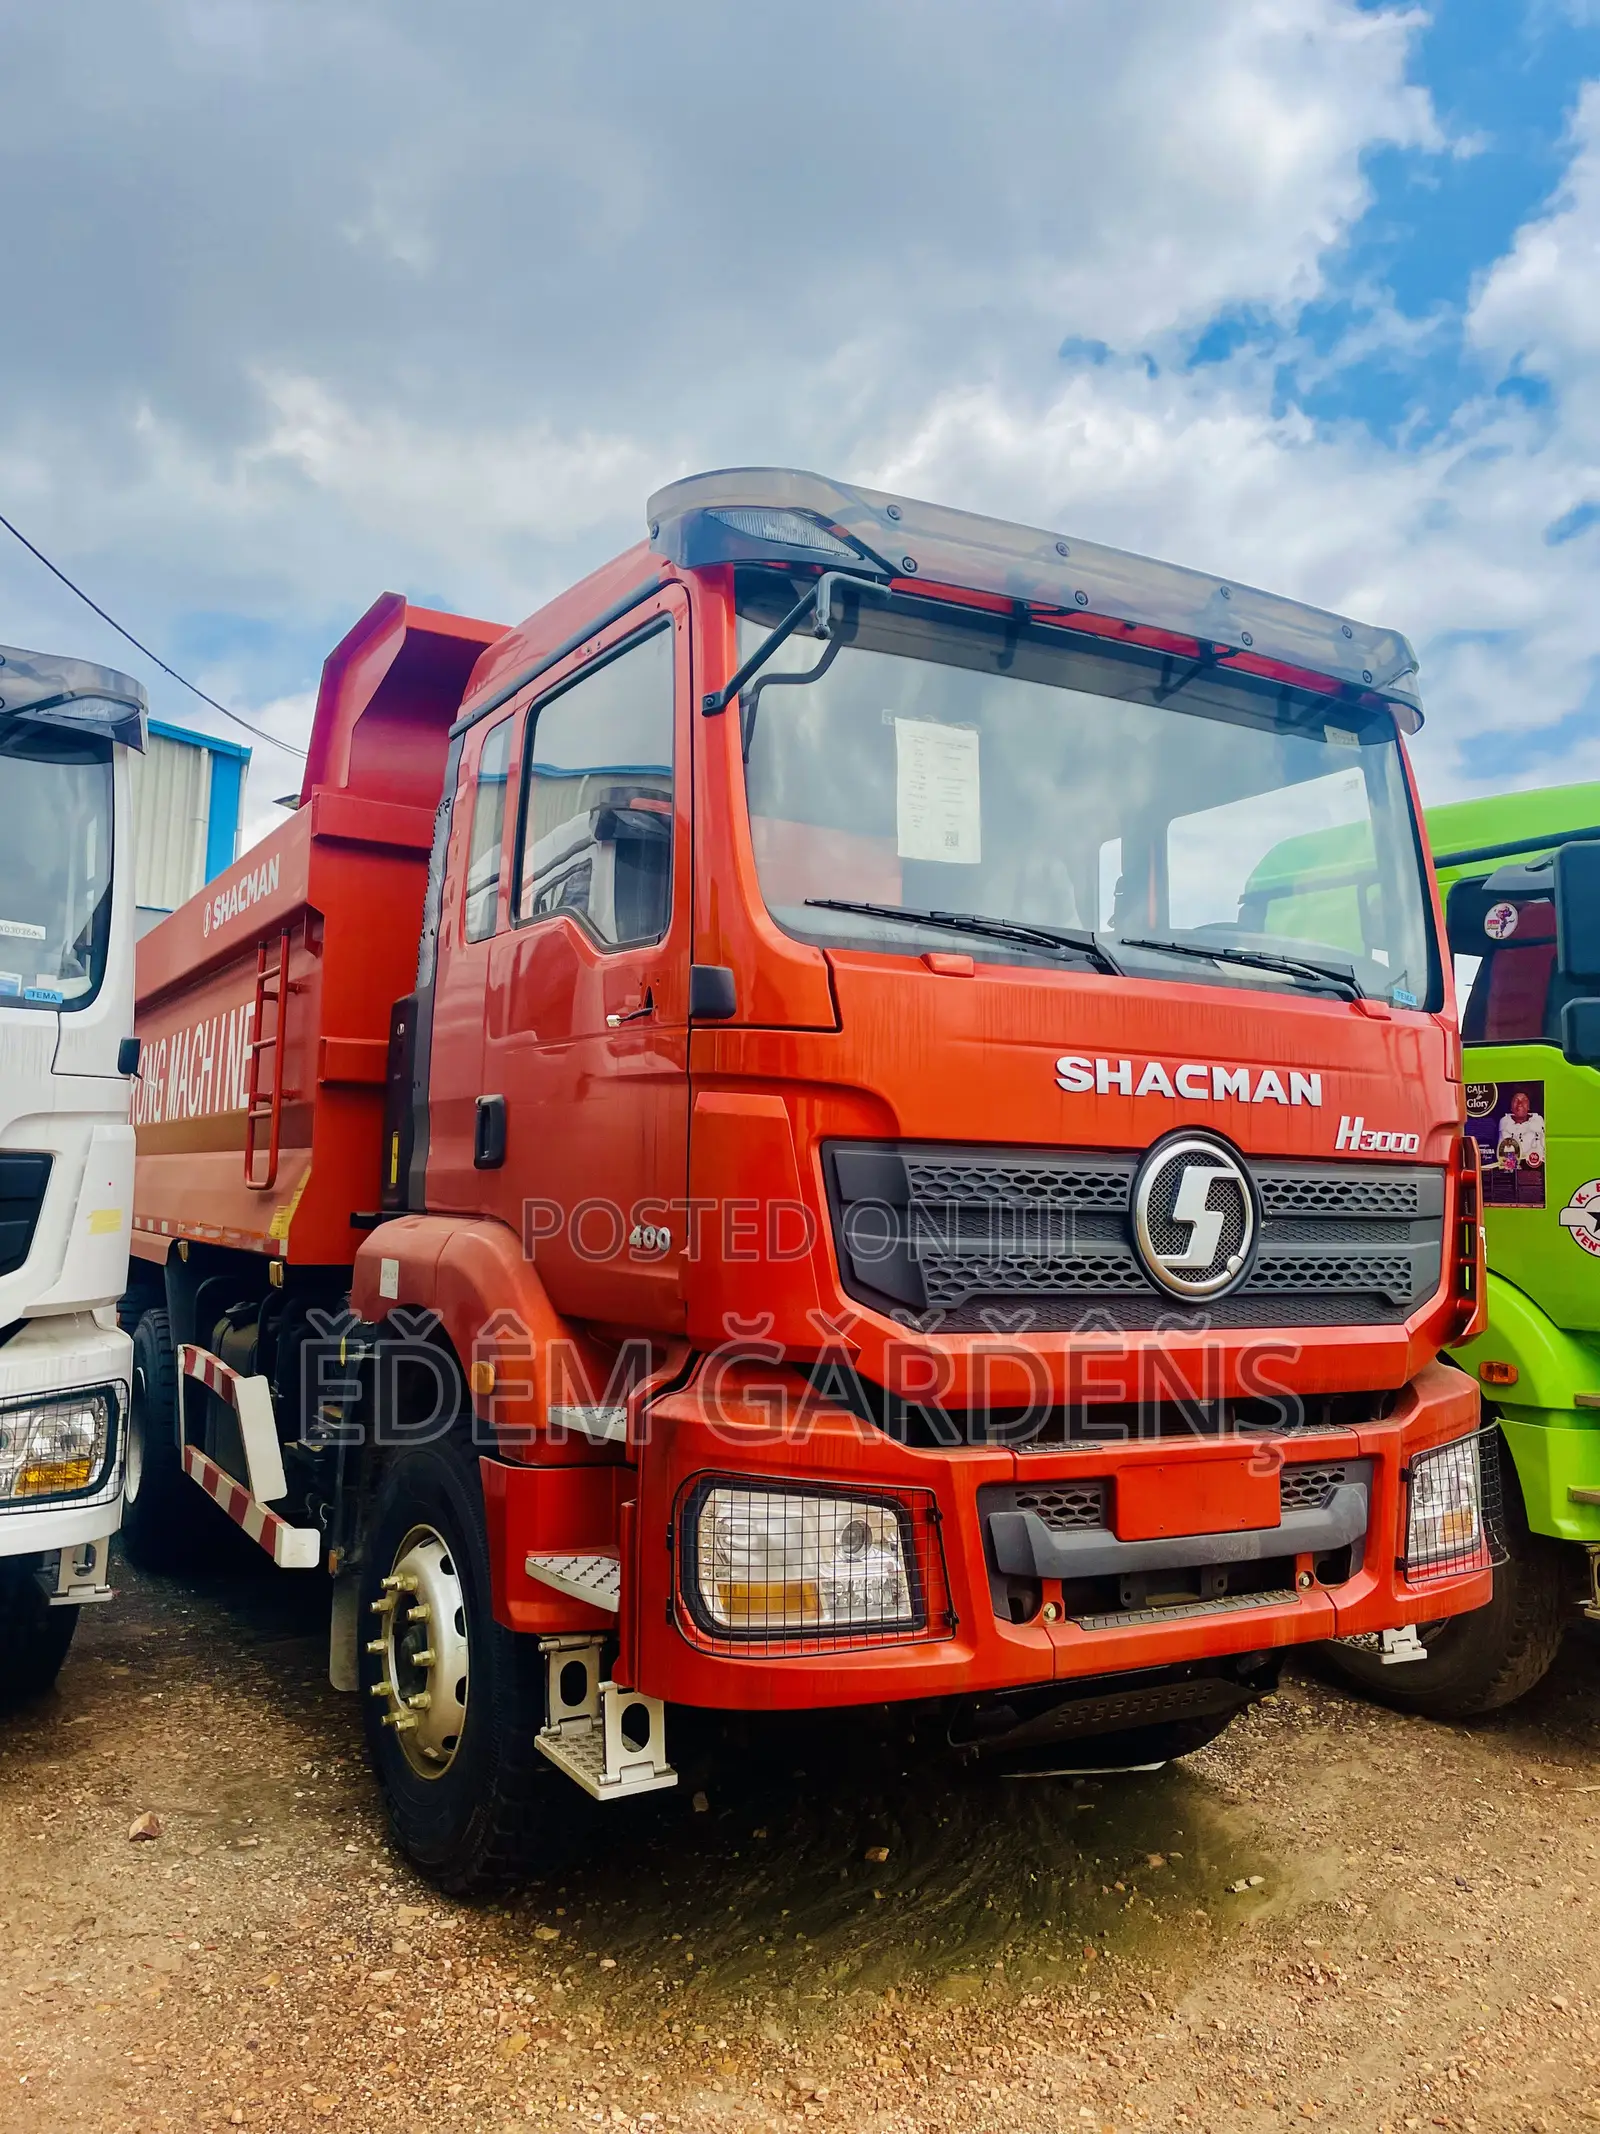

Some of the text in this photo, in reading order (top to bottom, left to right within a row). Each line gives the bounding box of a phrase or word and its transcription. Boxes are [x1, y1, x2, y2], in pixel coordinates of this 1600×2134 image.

[213, 853, 280, 930] SHACMAN
[30, 990, 57, 1001] TEMA
[166, 1001, 257, 1122] MACHINE
[1056, 1056, 1323, 1107] SHACMAN
[1466, 1085, 1488, 1093] CALL
[1466, 1098, 1489, 1109] Glory
[1335, 1115, 1420, 1154] H3000
[629, 1224, 671, 1251] 400
